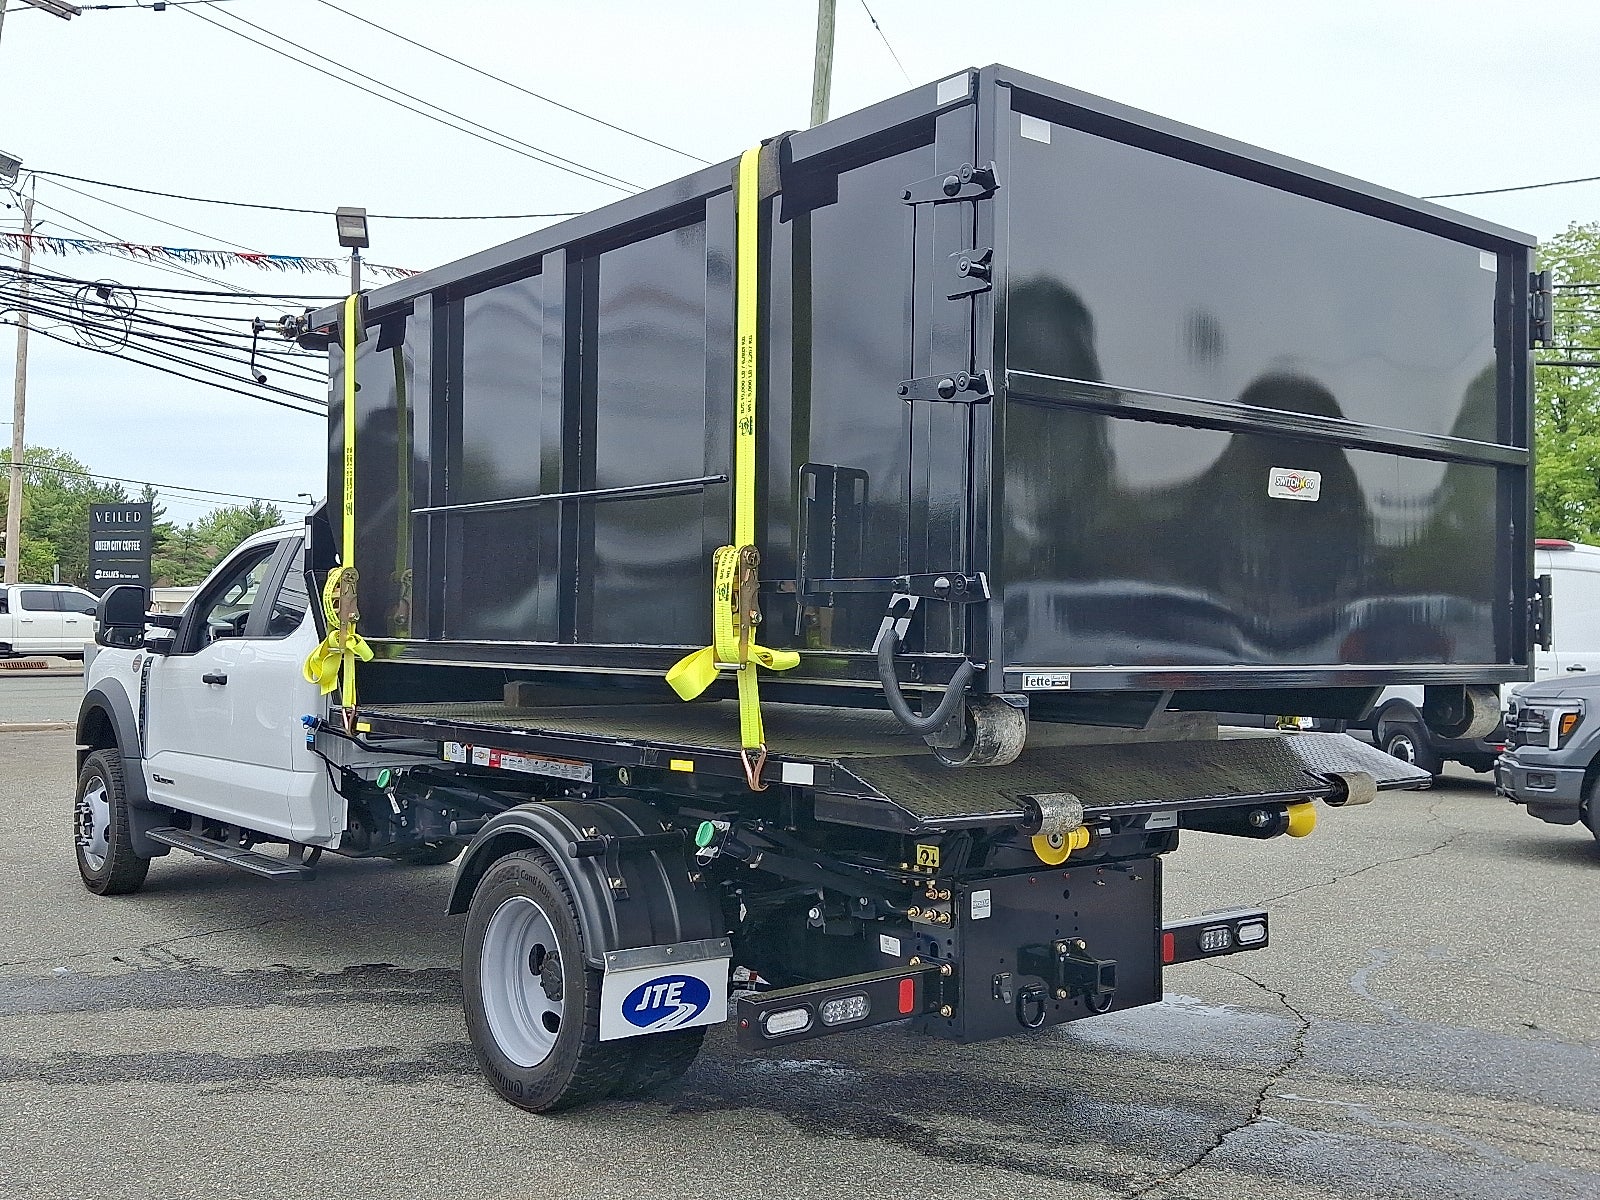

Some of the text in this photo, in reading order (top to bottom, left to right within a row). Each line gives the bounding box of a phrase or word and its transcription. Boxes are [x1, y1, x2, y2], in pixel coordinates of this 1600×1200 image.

[1275, 476, 1299, 488] SWITCH
[95, 511, 141, 523] VEILED
[94, 540, 141, 551] QUEEN CITY COFFEE
[1025, 676, 1051, 687] Fette
[520, 869, 538, 886] Conti
[634, 981, 686, 1012] JTE
